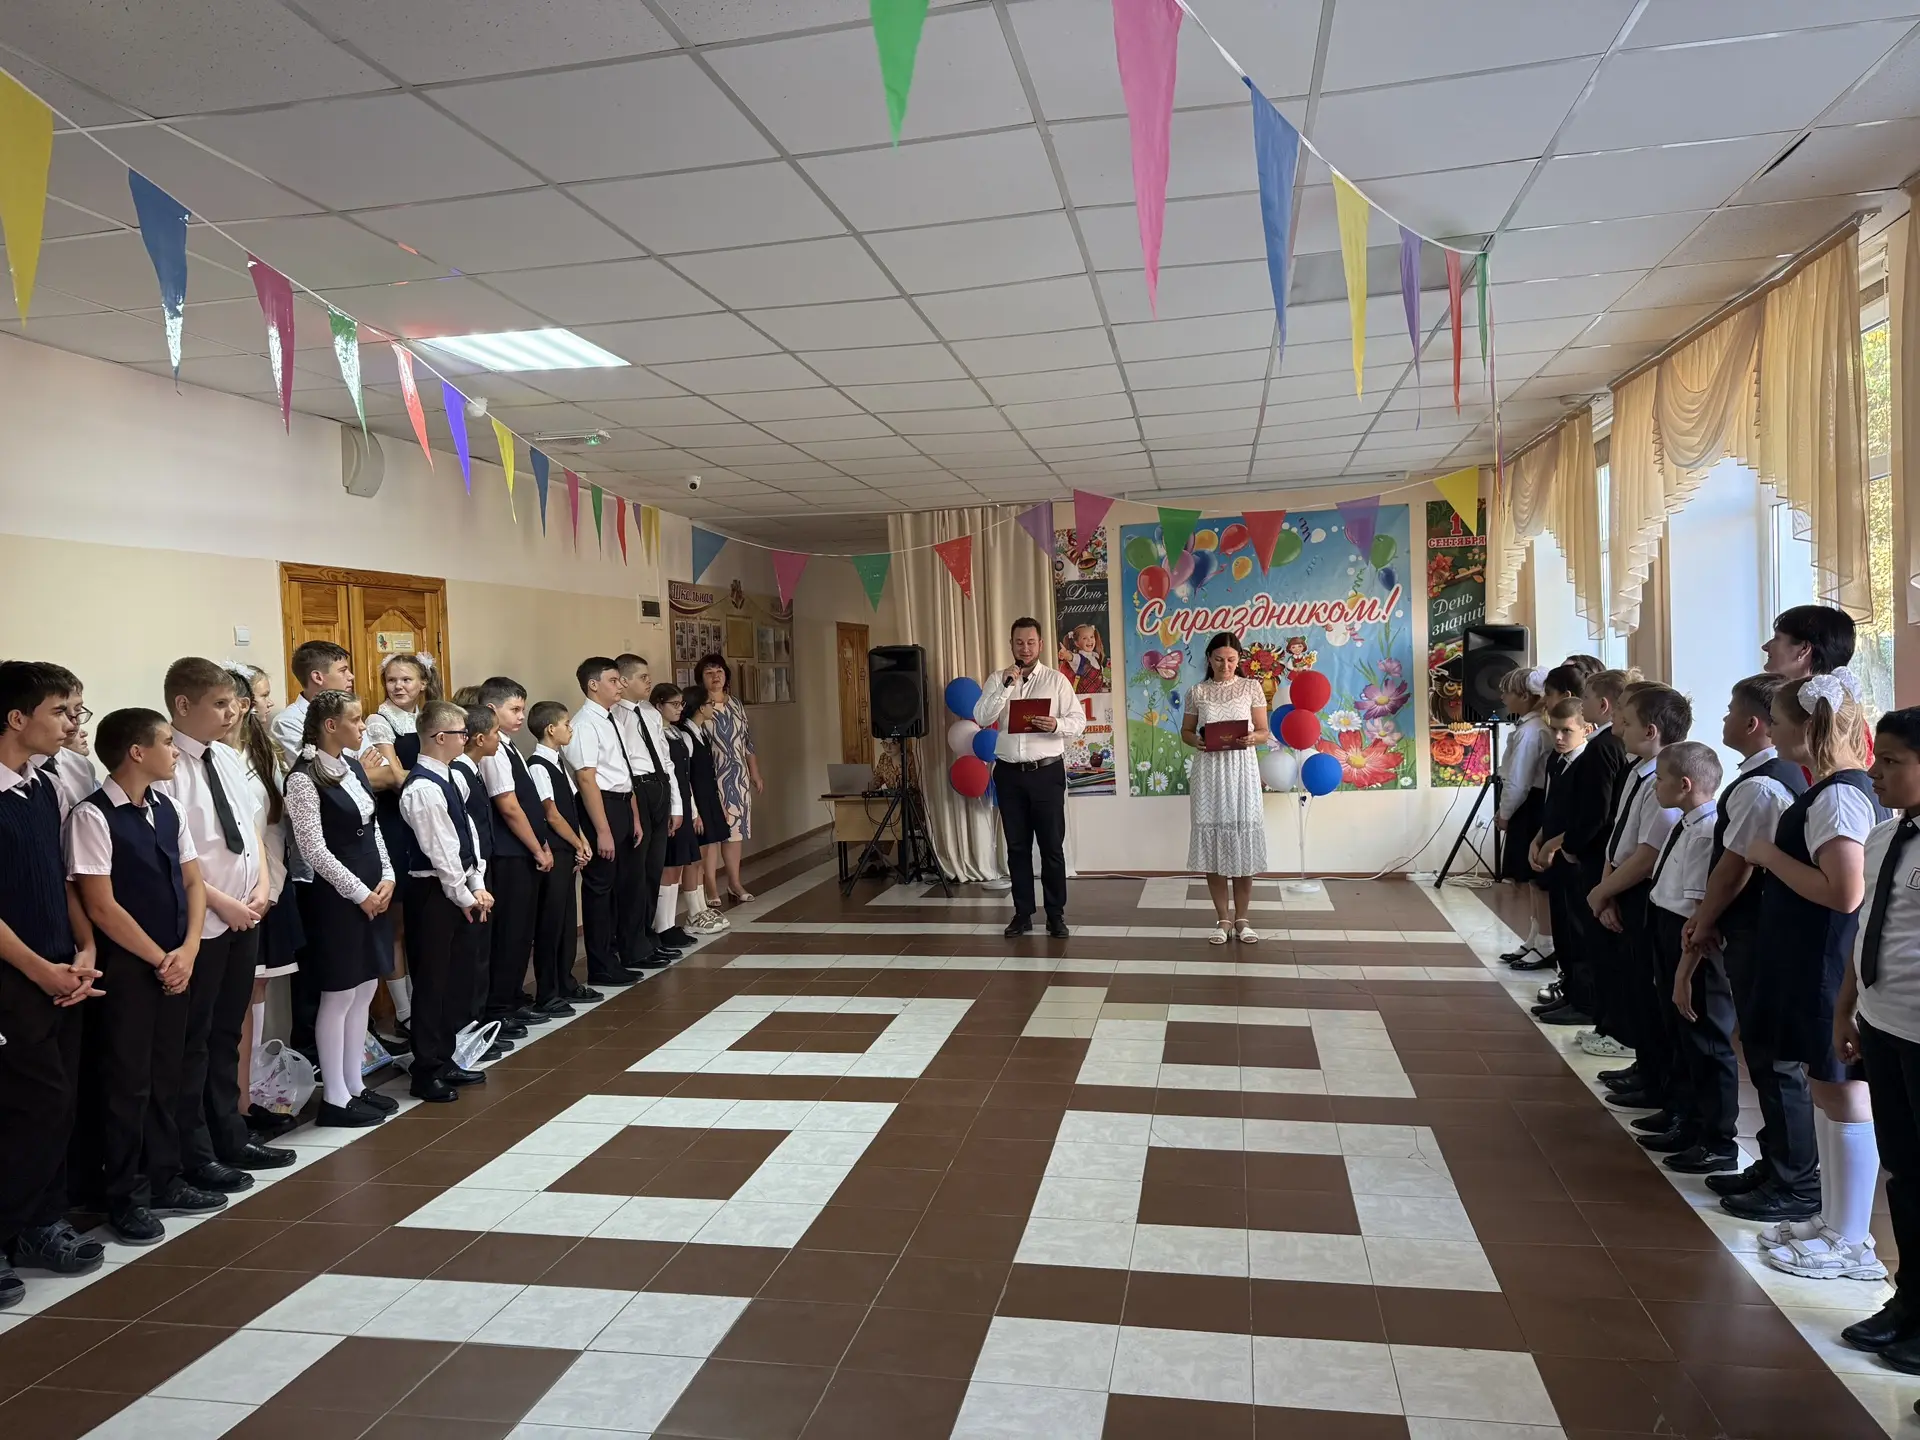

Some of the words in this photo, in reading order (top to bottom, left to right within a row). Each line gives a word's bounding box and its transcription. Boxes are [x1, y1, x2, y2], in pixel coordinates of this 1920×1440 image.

[1450, 512, 1462, 535] 1
[1428, 536, 1485, 547] СЕНТЯБРЯ
[671, 583, 714, 604] Школьная
[1065, 583, 1102, 600] День
[1057, 600, 1108, 621] знаний
[1139, 600, 1163, 633] С
[1170, 586, 1401, 641] праздником!
[1433, 593, 1473, 616] День
[1432, 602, 1485, 636] знаний
